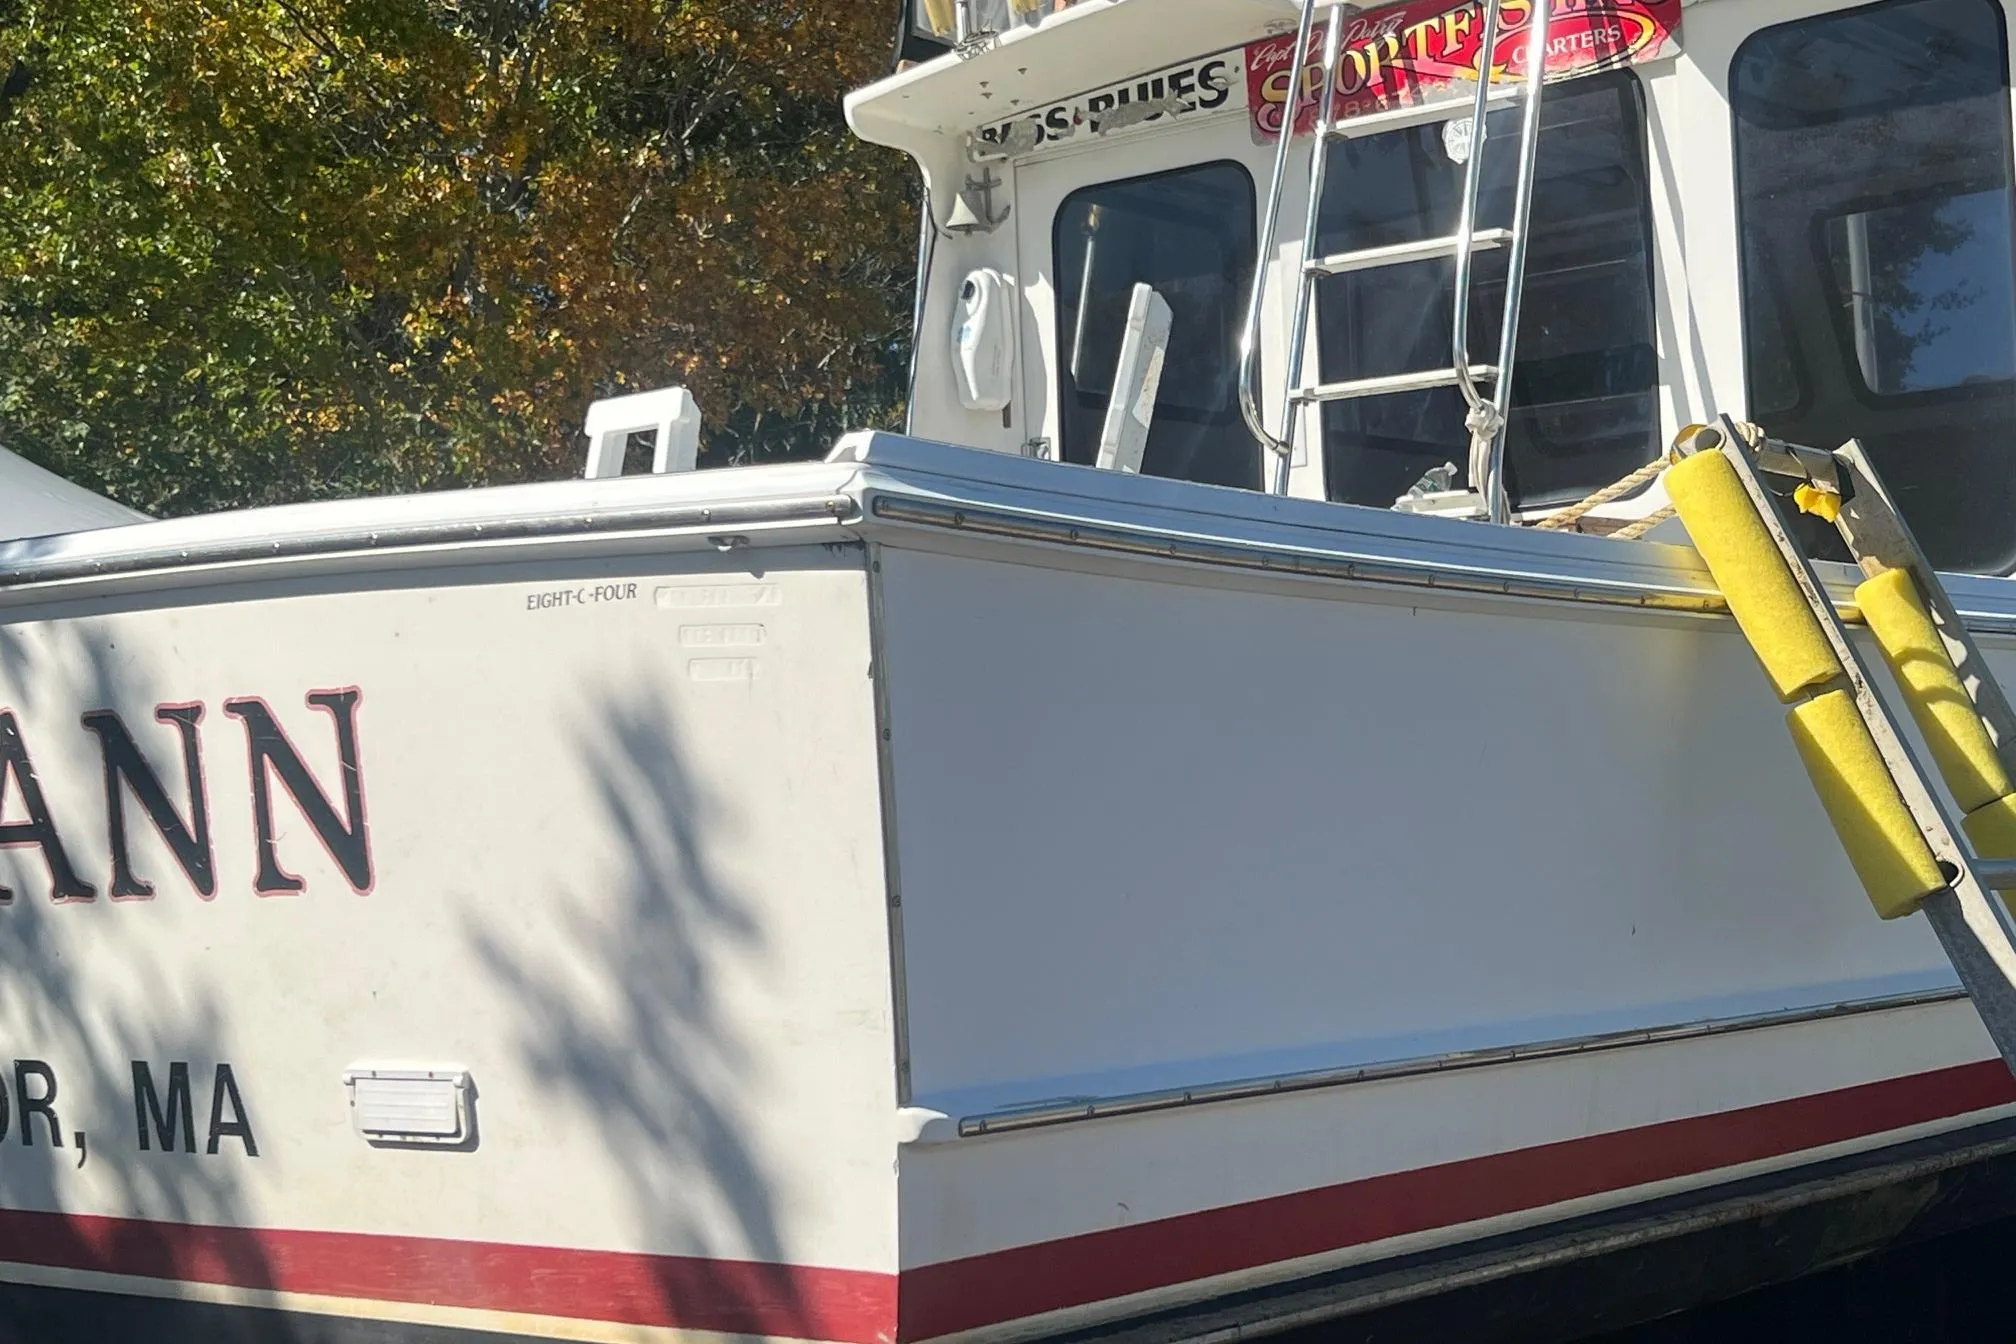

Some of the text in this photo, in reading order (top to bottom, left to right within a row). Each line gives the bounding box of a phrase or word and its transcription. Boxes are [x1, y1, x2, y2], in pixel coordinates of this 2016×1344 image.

[1256, 0, 1664, 134] SPORTFS
[1511, 24, 1622, 65] CARTERS
[0, 1058, 260, 1169] R, MA
